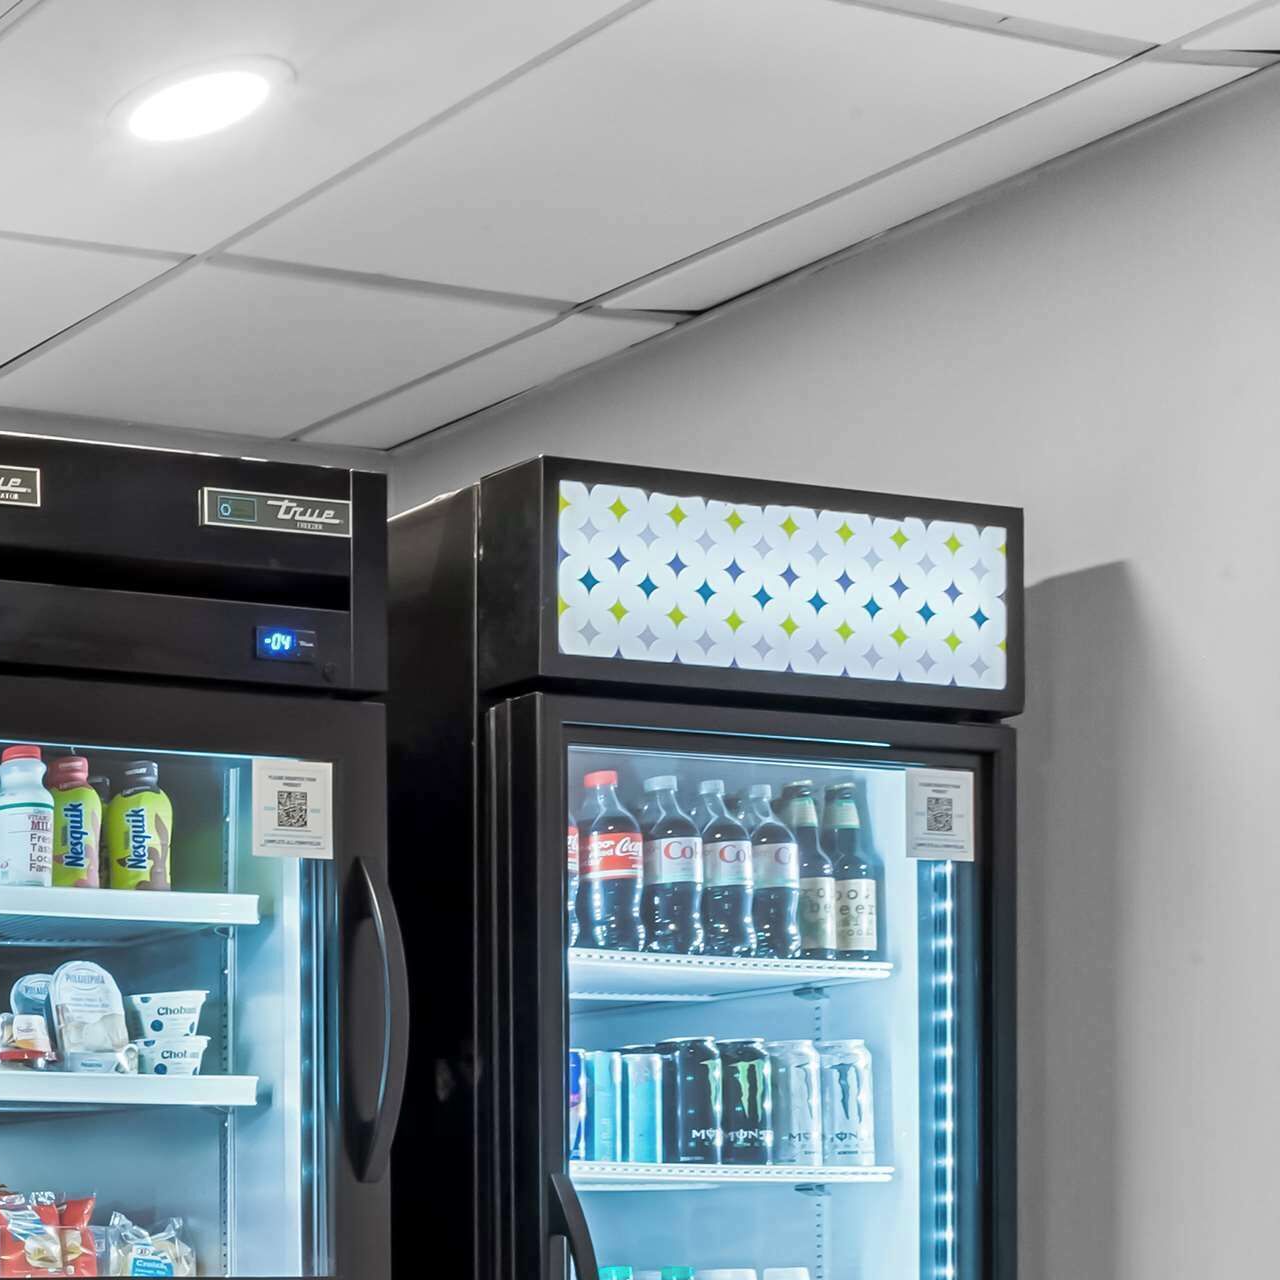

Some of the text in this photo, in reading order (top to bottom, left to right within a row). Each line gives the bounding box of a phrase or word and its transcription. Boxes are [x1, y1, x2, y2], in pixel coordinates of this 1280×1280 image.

[267, 500, 340, 523] true
[64, 802, 84, 868] Nesquik
[127, 807, 146, 870] Nesquik
